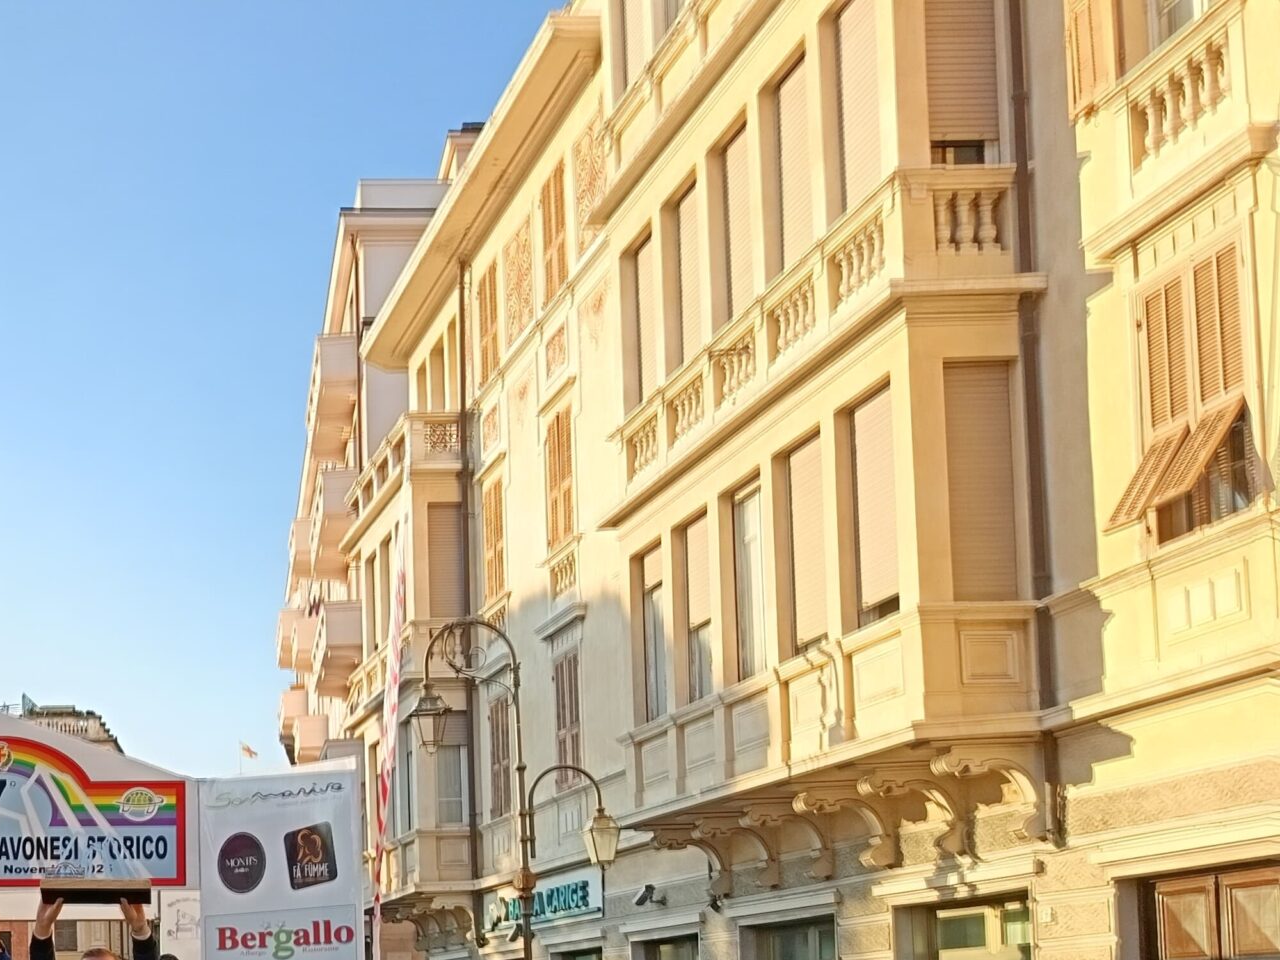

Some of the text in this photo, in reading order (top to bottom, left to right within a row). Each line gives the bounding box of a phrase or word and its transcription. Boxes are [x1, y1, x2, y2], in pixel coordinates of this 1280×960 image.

[86, 835, 168, 860] STORICO
[545, 879, 589, 914] CARIGE
[216, 919, 355, 960] Bergallo
